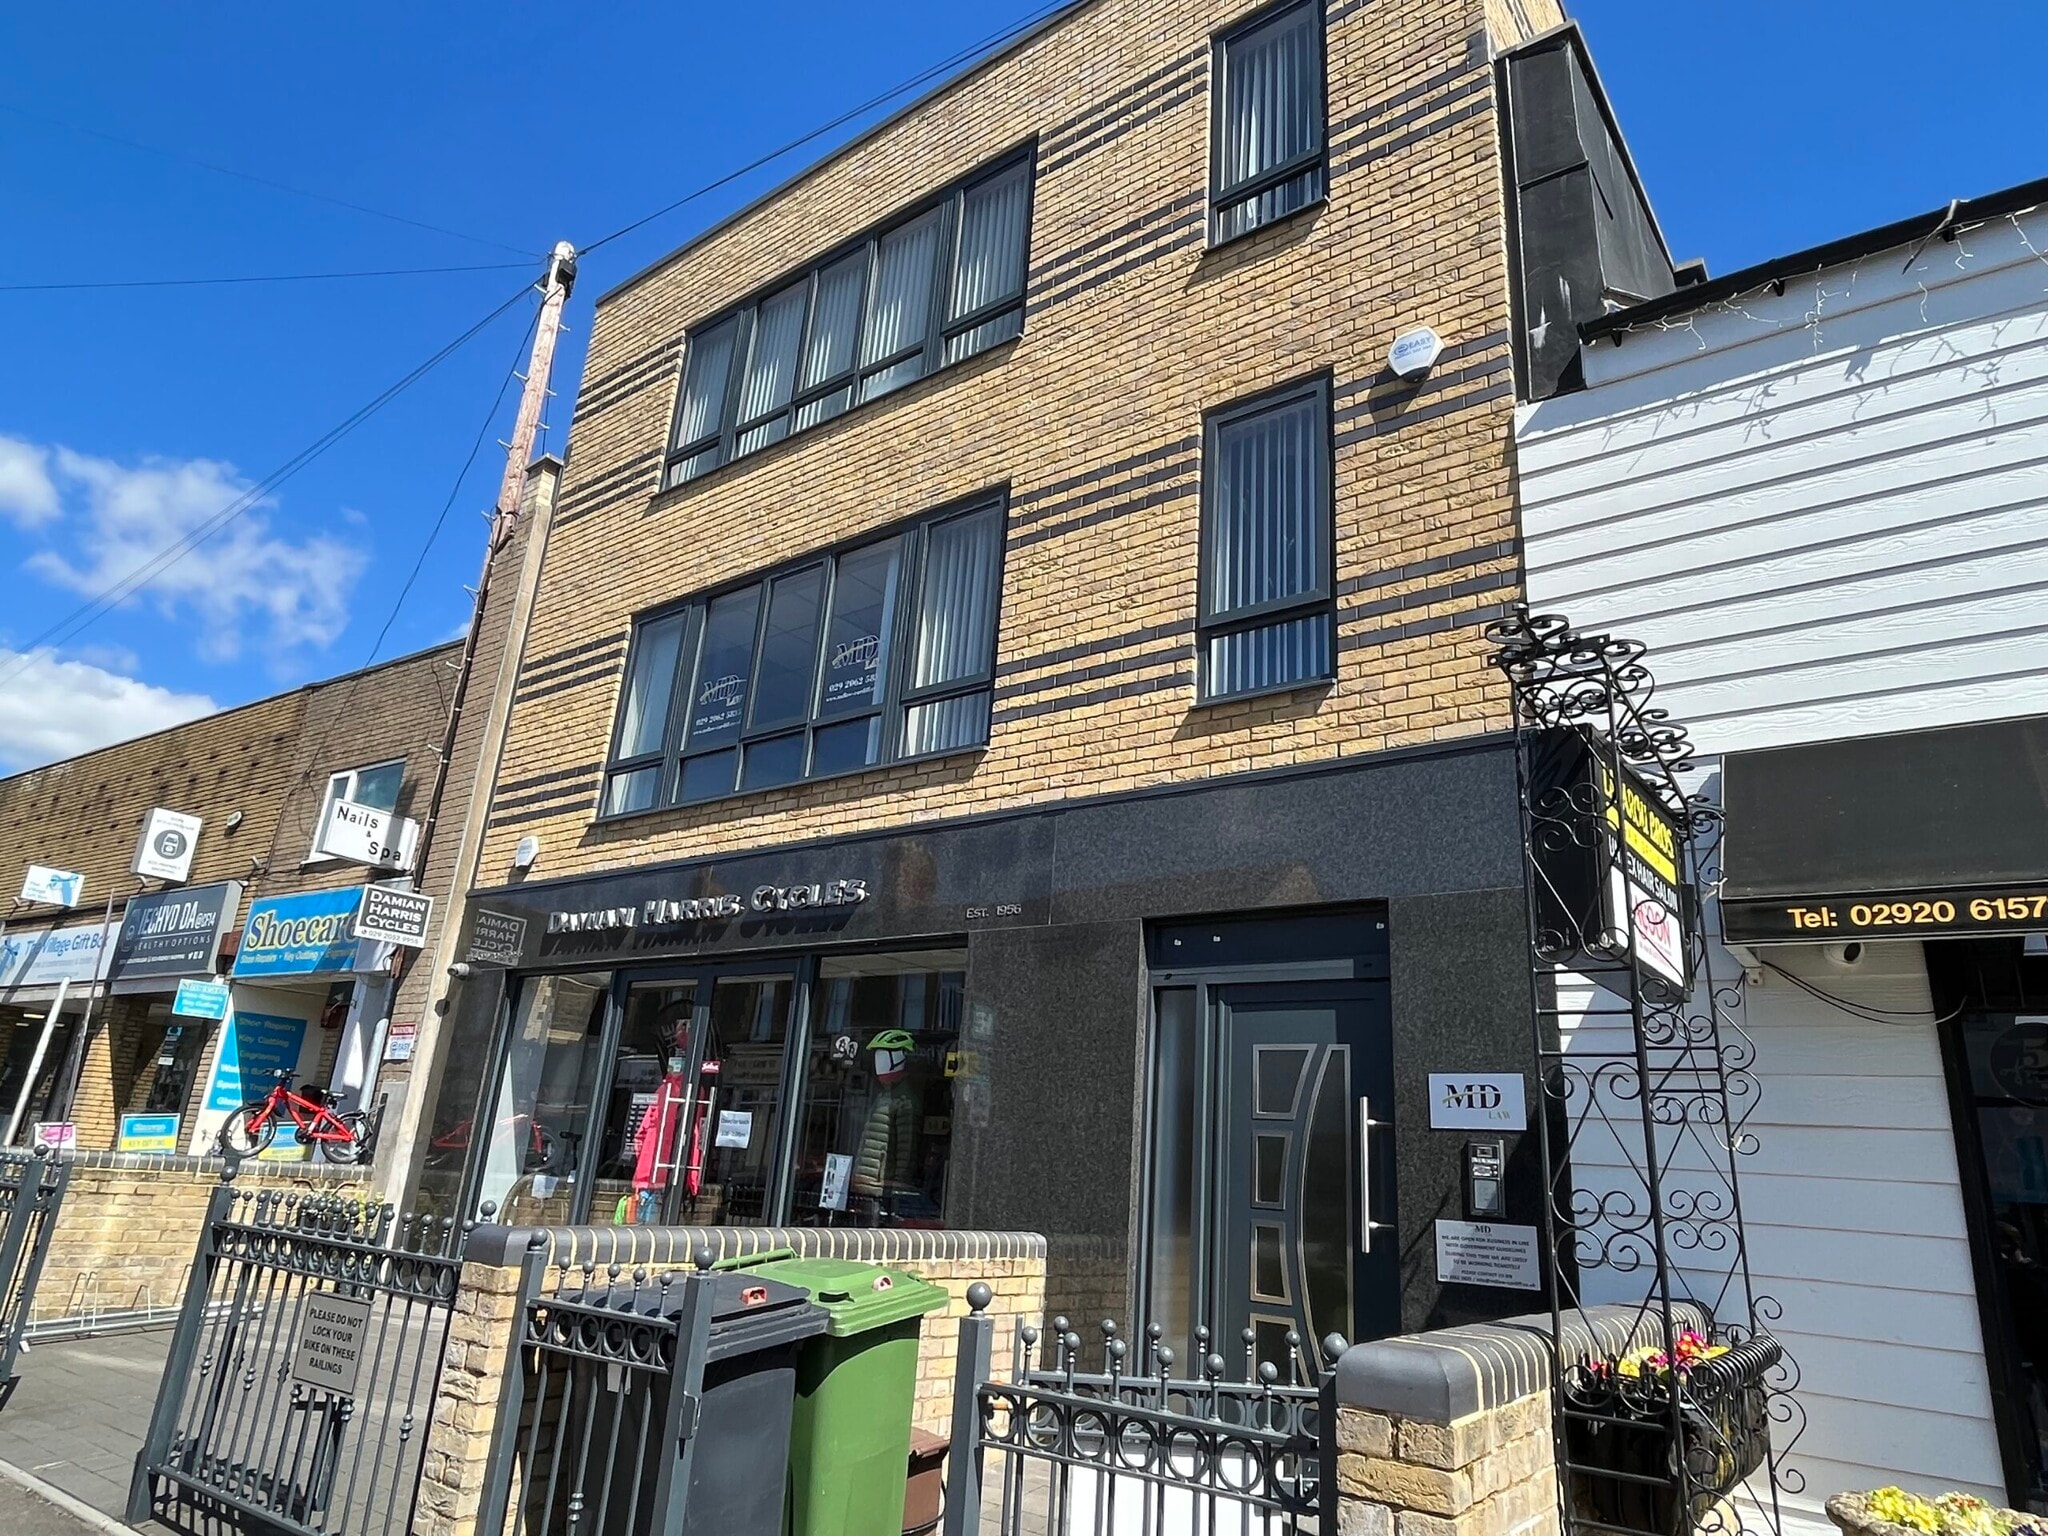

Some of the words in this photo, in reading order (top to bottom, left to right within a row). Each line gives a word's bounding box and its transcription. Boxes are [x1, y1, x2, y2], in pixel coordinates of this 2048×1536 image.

[337, 806, 379, 829] Nails
[368, 841, 402, 862] Spa
[1637, 860, 1655, 893] HAIR
[1655, 876, 1678, 913] SALON
[370, 890, 426, 912] DAMIAN
[547, 906, 638, 935] DAMIAN
[642, 894, 745, 925] HARRIS
[751, 879, 870, 913] CYCLES
[996, 904, 1022, 916] 1956
[138, 904, 180, 935] IECHYD
[368, 903, 422, 923] HARRIS
[1787, 906, 1839, 929] Tel:
[1850, 900, 1957, 926] 02920
[1969, 895, 2048, 921] 6157
[244, 909, 358, 952] Shoecare
[366, 915, 420, 934] CYCLES
[171, 935, 212, 948] OPTIONS
[1443, 1084, 1502, 1109] MD
[1488, 1111, 1511, 1120] LAW
[1474, 1225, 1491, 1234] MD
[310, 1308, 336, 1323] PLEASE
[336, 1314, 347, 1325] DO
[347, 1316, 363, 1329] NOT
[312, 1325, 331, 1338] LOCK
[332, 1331, 352, 1343] YOUR
[304, 1339, 320, 1352] BIKE
[320, 1343, 331, 1355] ON
[332, 1346, 356, 1361] THESE
[309, 1357, 342, 1374] RAILINGS
